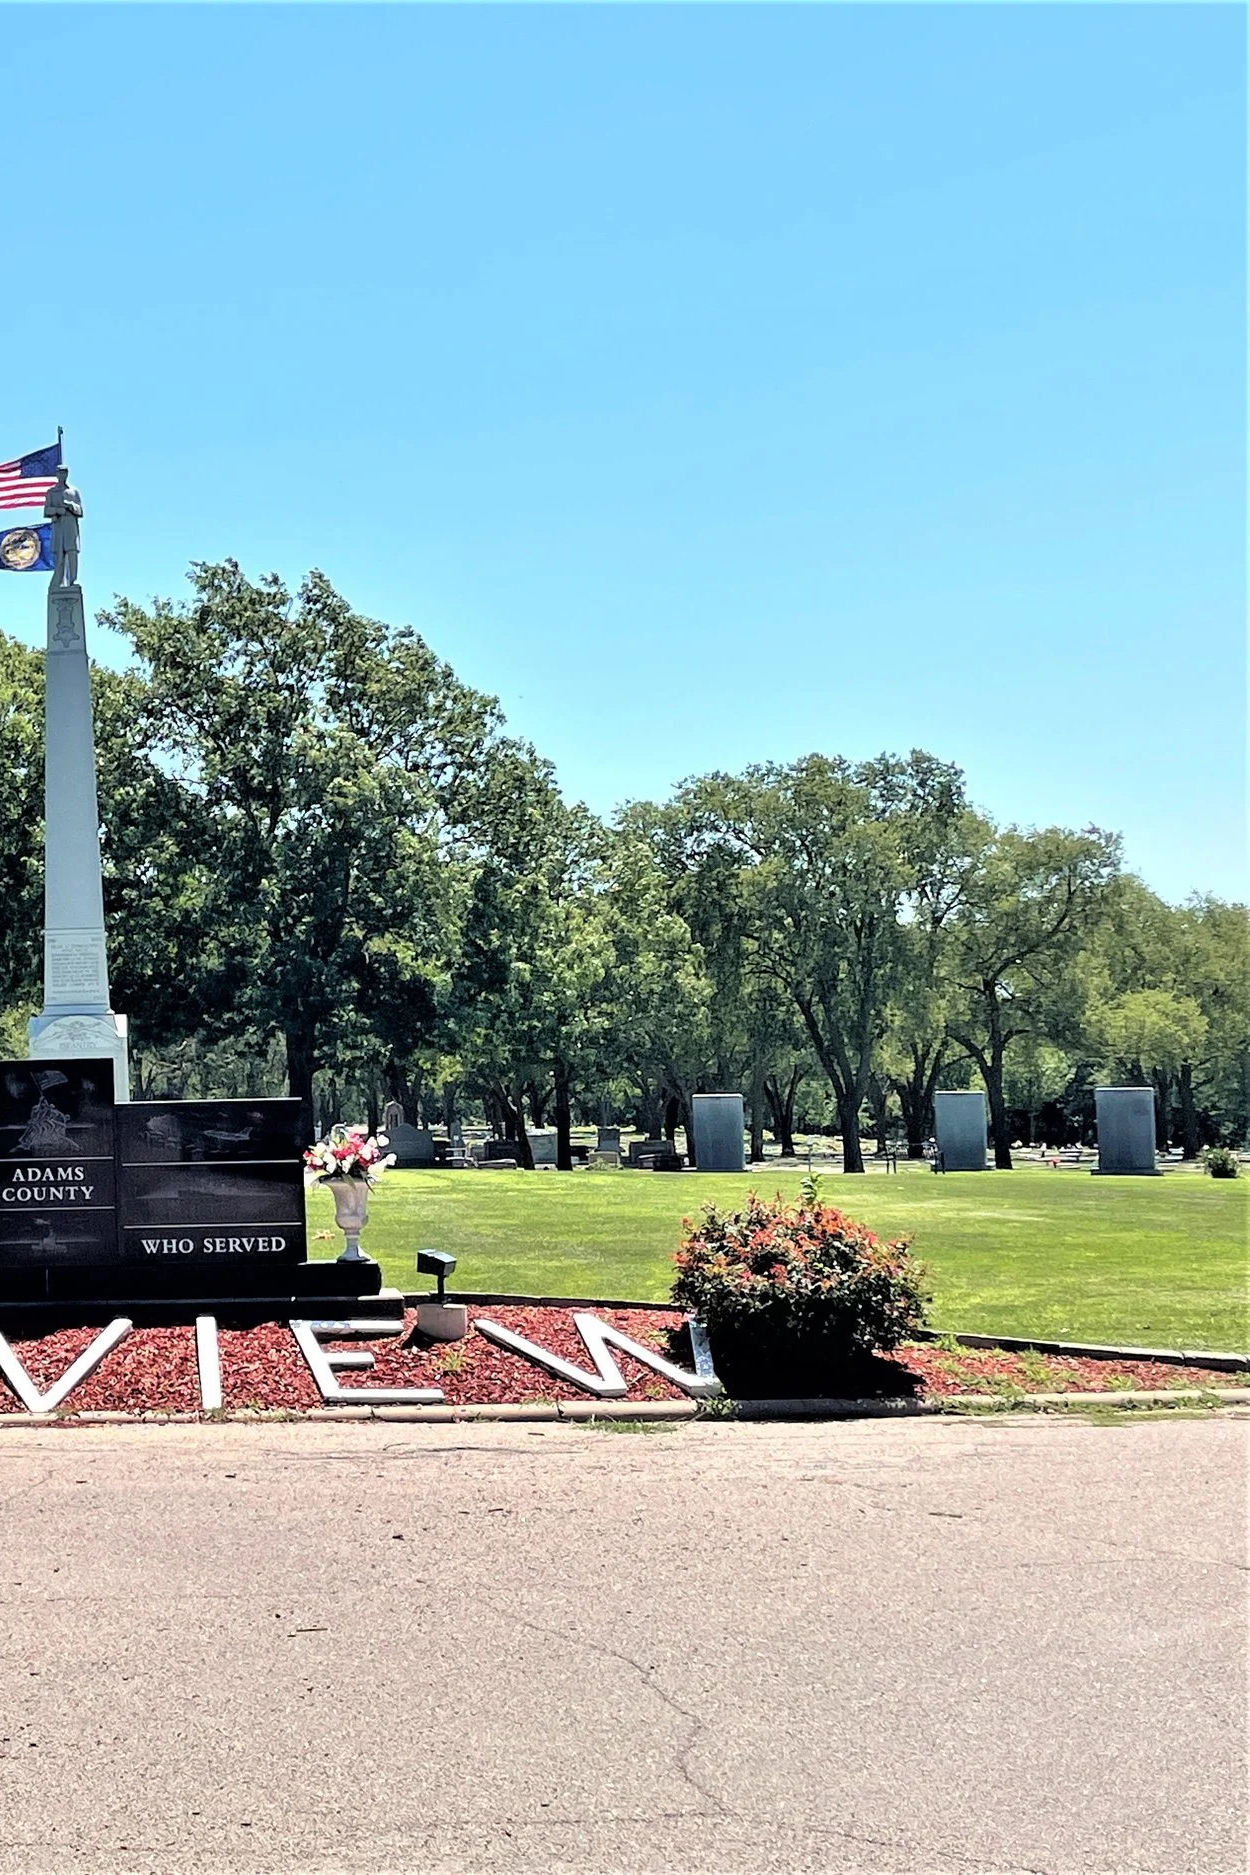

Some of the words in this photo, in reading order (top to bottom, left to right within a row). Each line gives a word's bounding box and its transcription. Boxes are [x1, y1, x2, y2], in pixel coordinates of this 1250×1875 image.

[12, 1166, 85, 1182] ADAMS
[1, 1185, 95, 1202] COUNTY
[140, 1238, 194, 1254] WHO
[203, 1236, 286, 1253] SERVED
